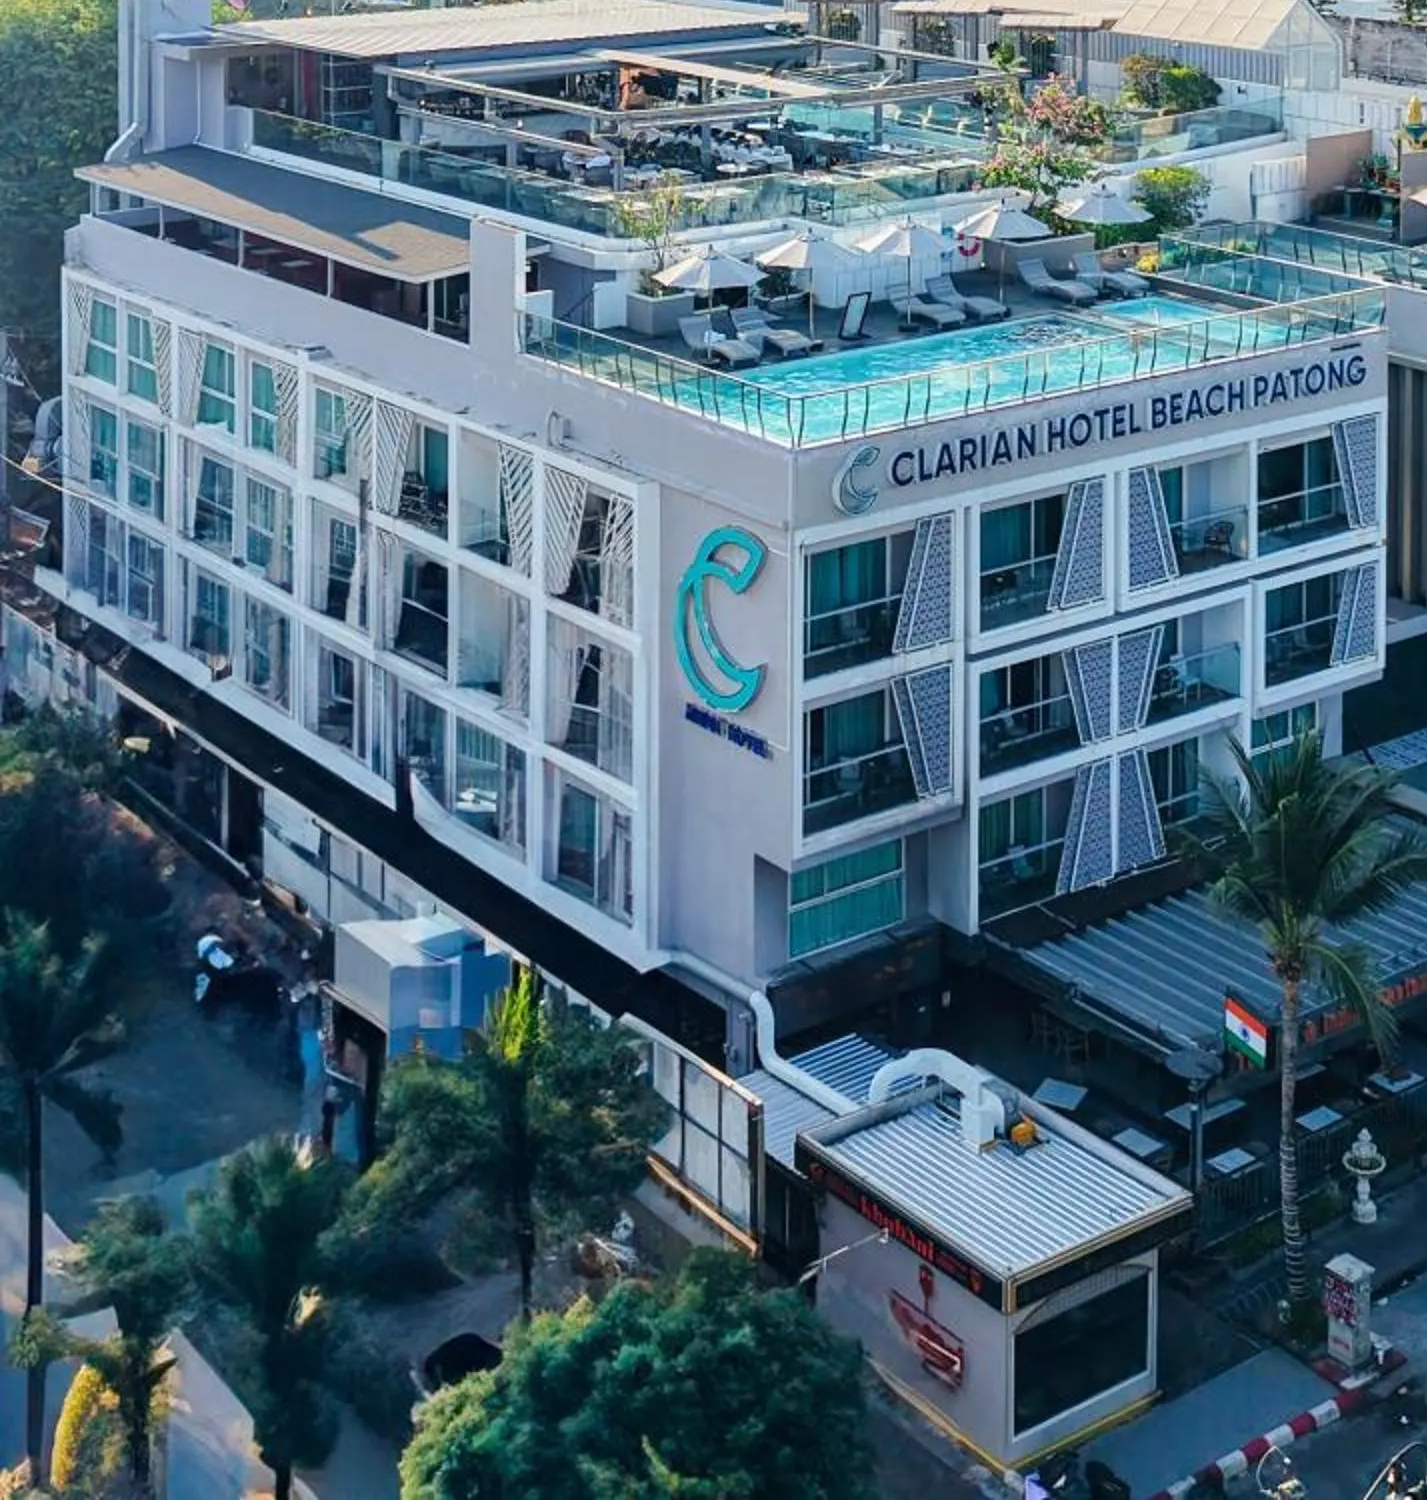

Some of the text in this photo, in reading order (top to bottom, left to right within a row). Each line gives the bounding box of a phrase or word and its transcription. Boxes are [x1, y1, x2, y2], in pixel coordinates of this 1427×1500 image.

[891, 354, 1367, 485] CLARIAN HOTEL BEACH PATONG
